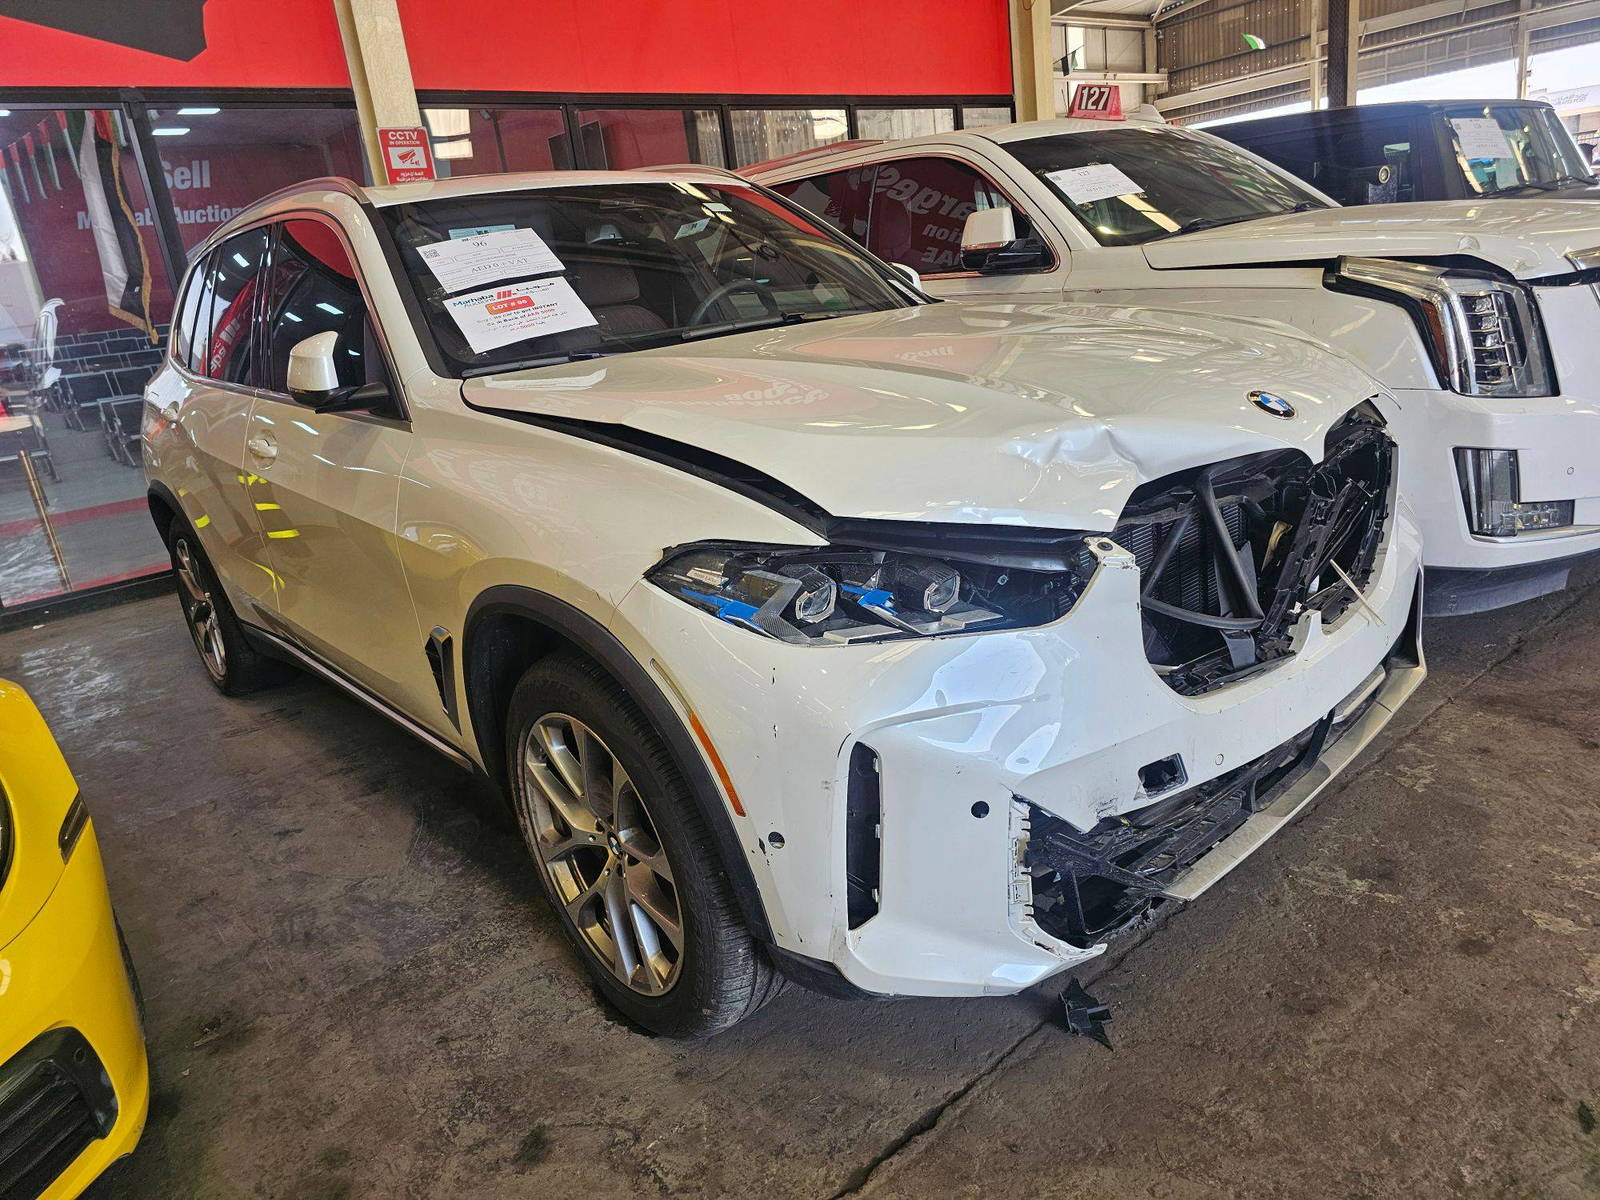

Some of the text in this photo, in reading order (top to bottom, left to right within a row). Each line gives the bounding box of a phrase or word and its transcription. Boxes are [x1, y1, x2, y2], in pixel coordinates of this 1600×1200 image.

[1080, 86, 1110, 110] 127
[388, 131, 418, 140] CCTV
[507, 258, 528, 266] VAT
[453, 294, 494, 307] Marhaba
[532, 302, 558, 310] INSTANT
